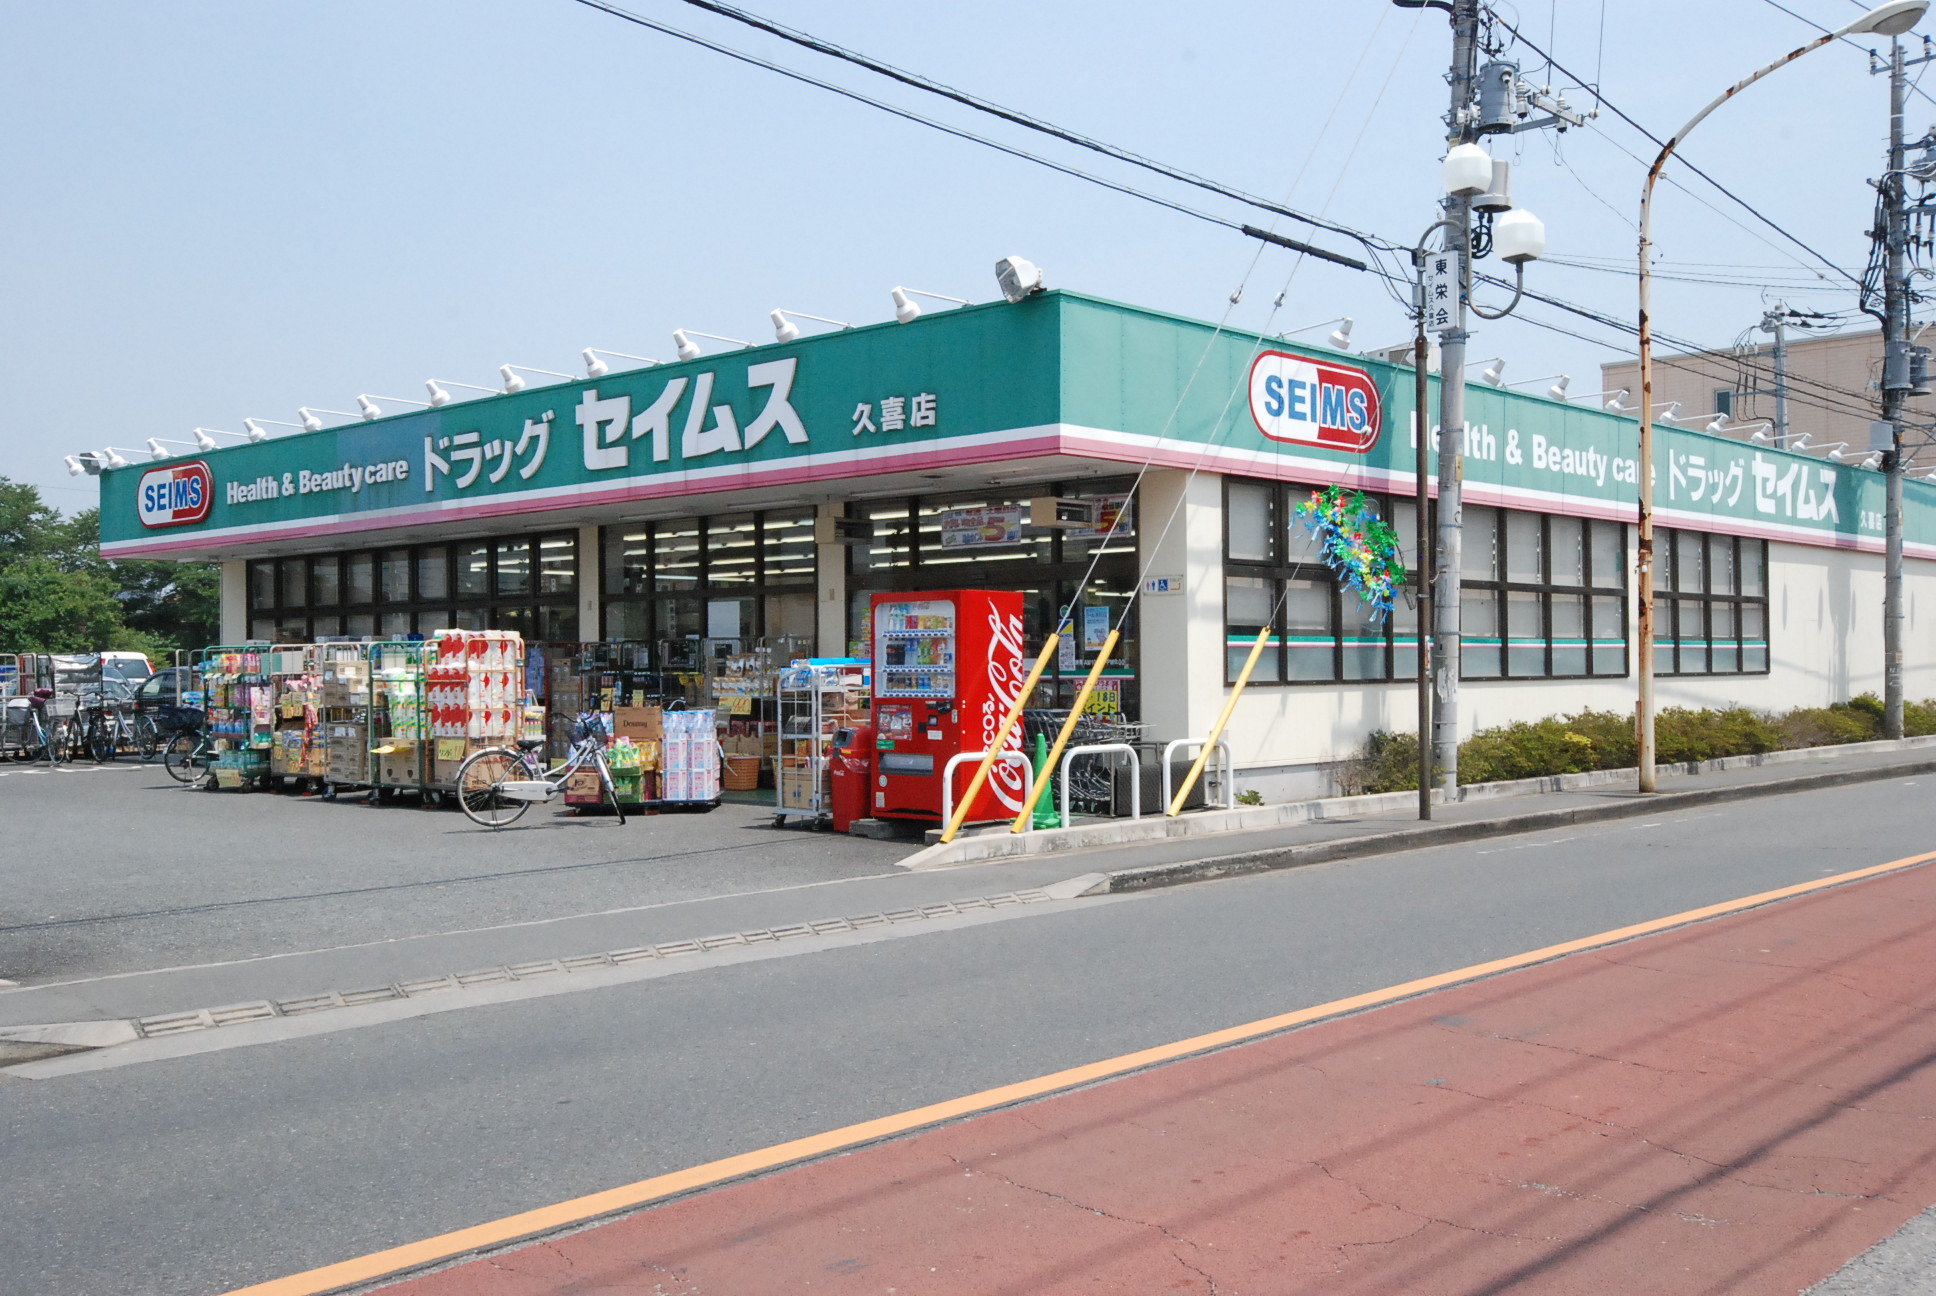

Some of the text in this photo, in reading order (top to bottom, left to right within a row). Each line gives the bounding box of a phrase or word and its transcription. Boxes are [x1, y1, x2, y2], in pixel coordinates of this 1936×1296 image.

[1435, 258, 1448, 326] 東栄会
[575, 357, 810, 470] セイムス
[851, 392, 938, 436] 久喜店
[1264, 374, 1369, 435] SEIMS
[424, 409, 555, 492] ドラッグ
[1506, 433, 1523, 465] &
[1532, 433, 1608, 487] Beauty
[1669, 448, 1745, 507] ドラッグ
[144, 477, 202, 513] SEIMS
[226, 457, 409, 505] Health & Beauty care
[1752, 451, 1840, 524] セイムス
[985, 516, 1006, 541] 5
[1860, 509, 1883, 531] 久喜店
